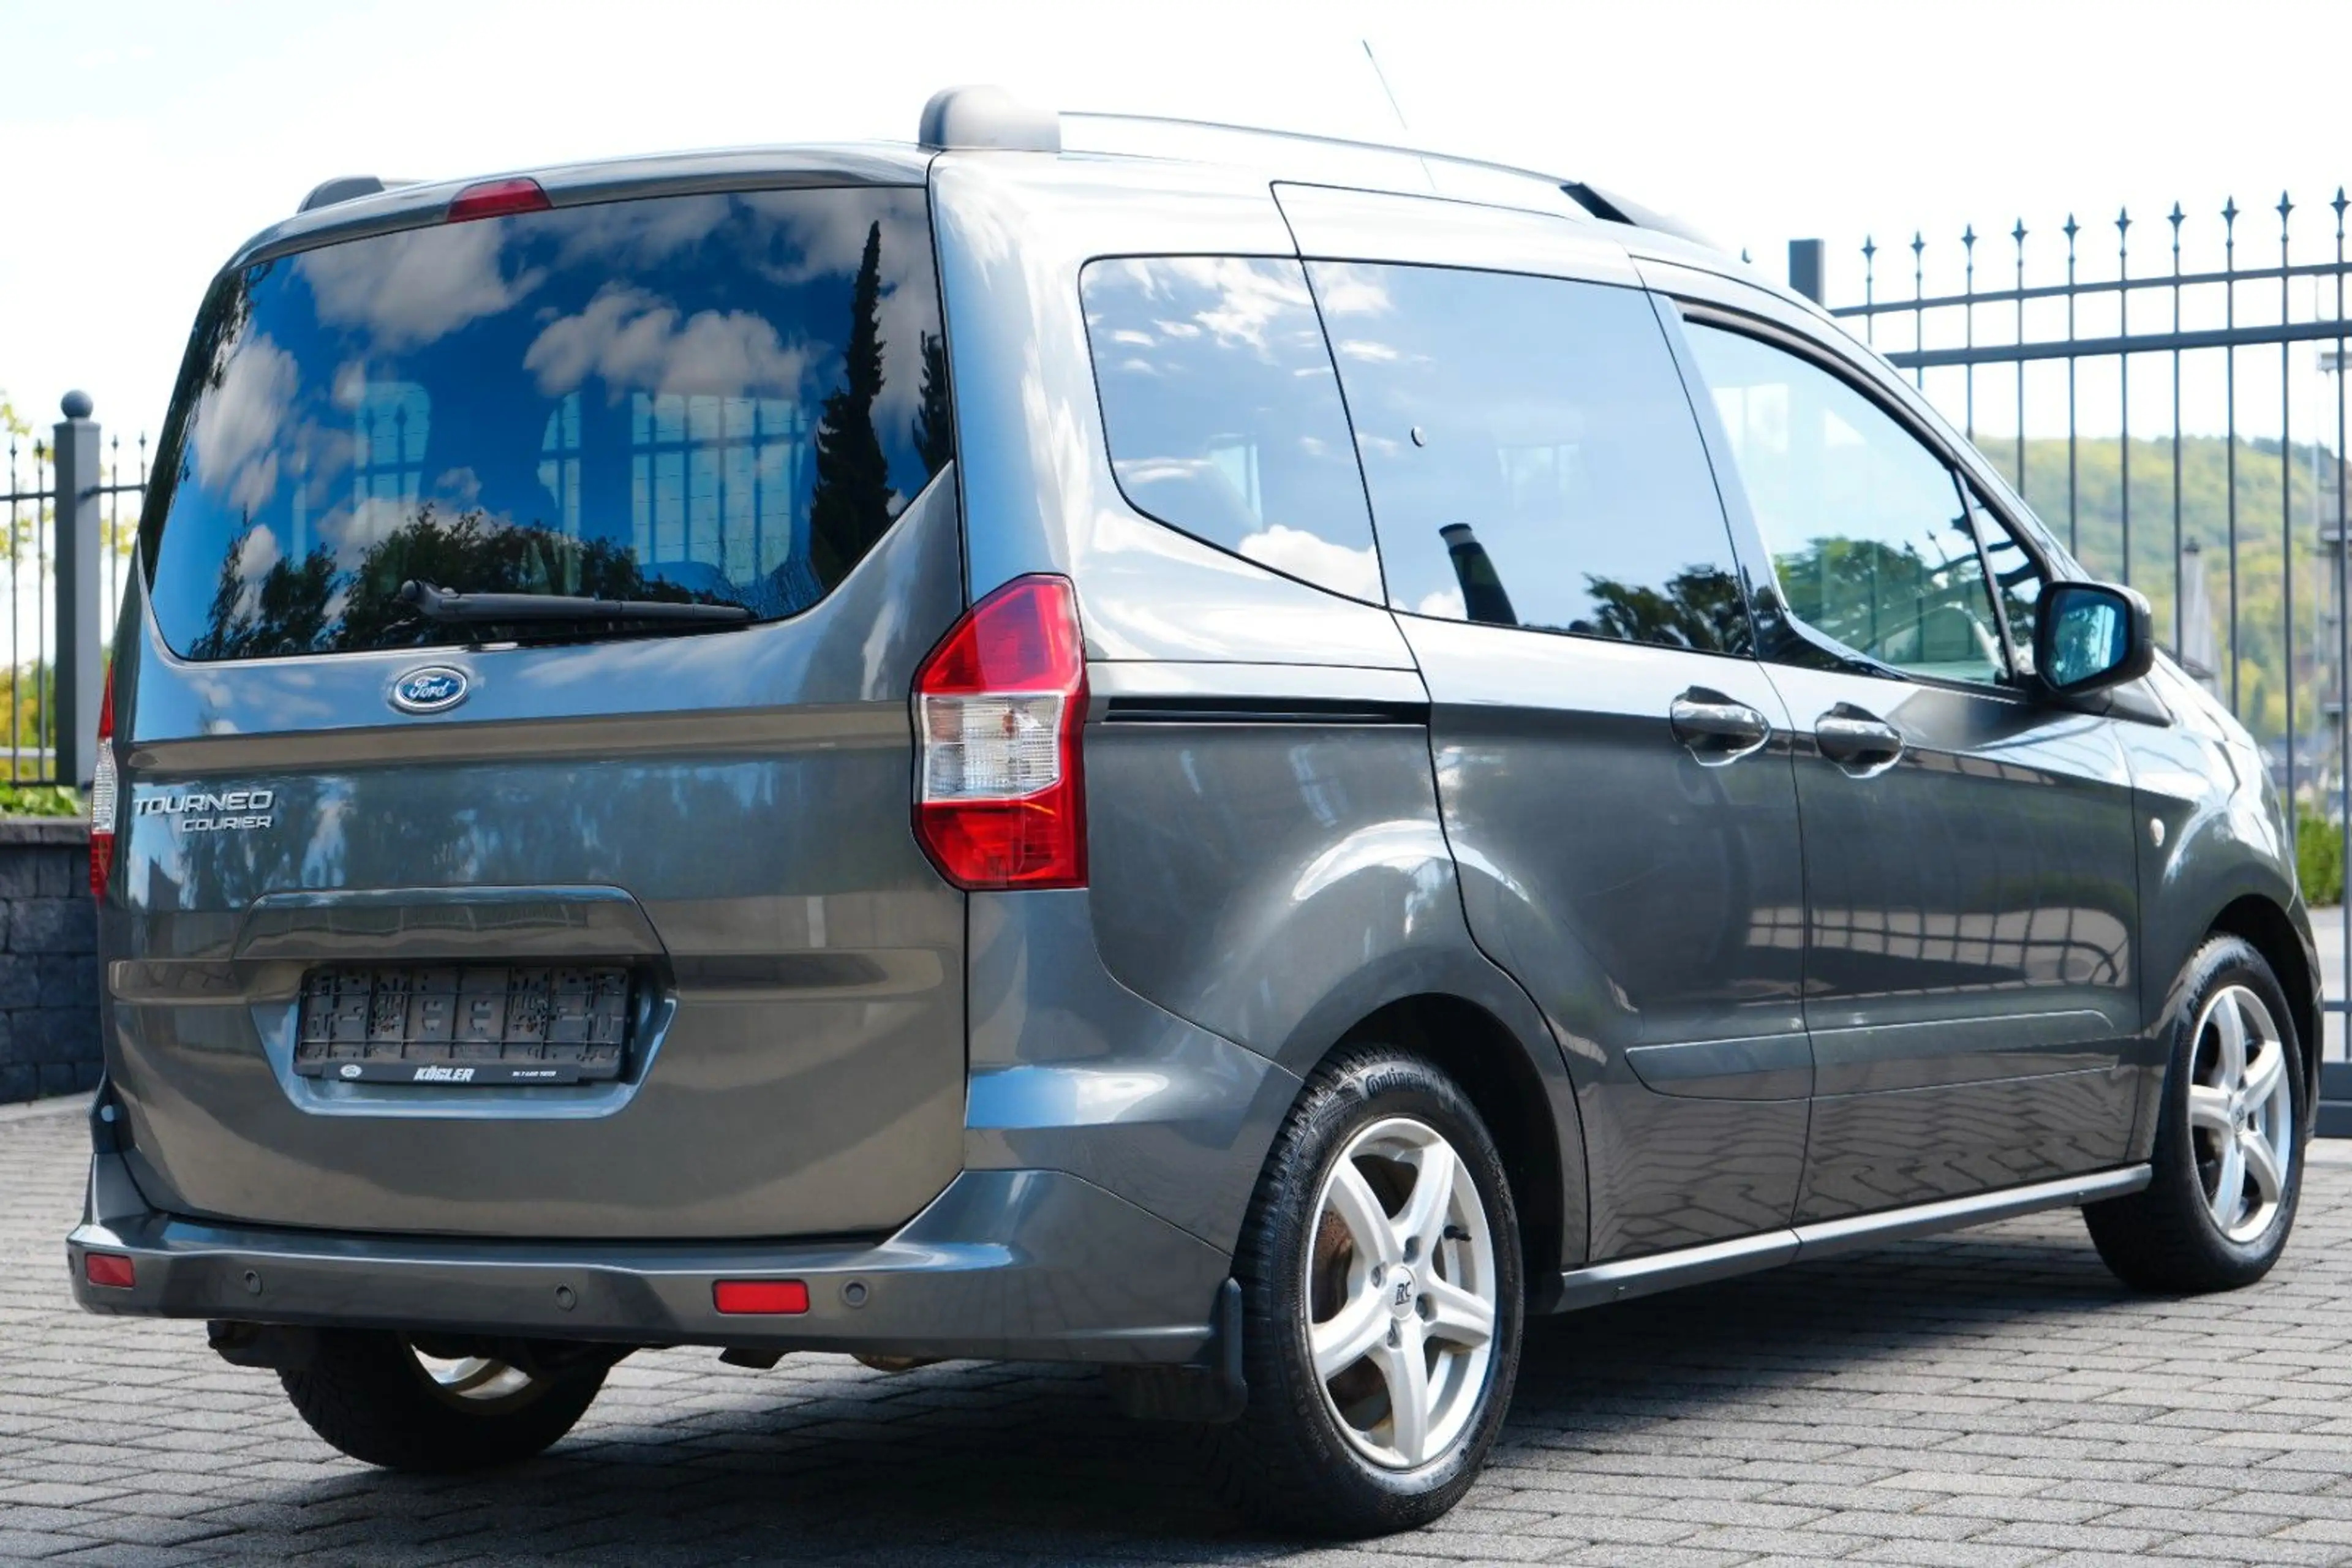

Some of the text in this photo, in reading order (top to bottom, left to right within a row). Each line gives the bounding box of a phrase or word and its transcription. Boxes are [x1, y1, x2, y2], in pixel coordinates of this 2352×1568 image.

[409, 676, 450, 699] Ford
[133, 790, 274, 816] TOURNEO
[182, 815, 273, 832] COURIER
